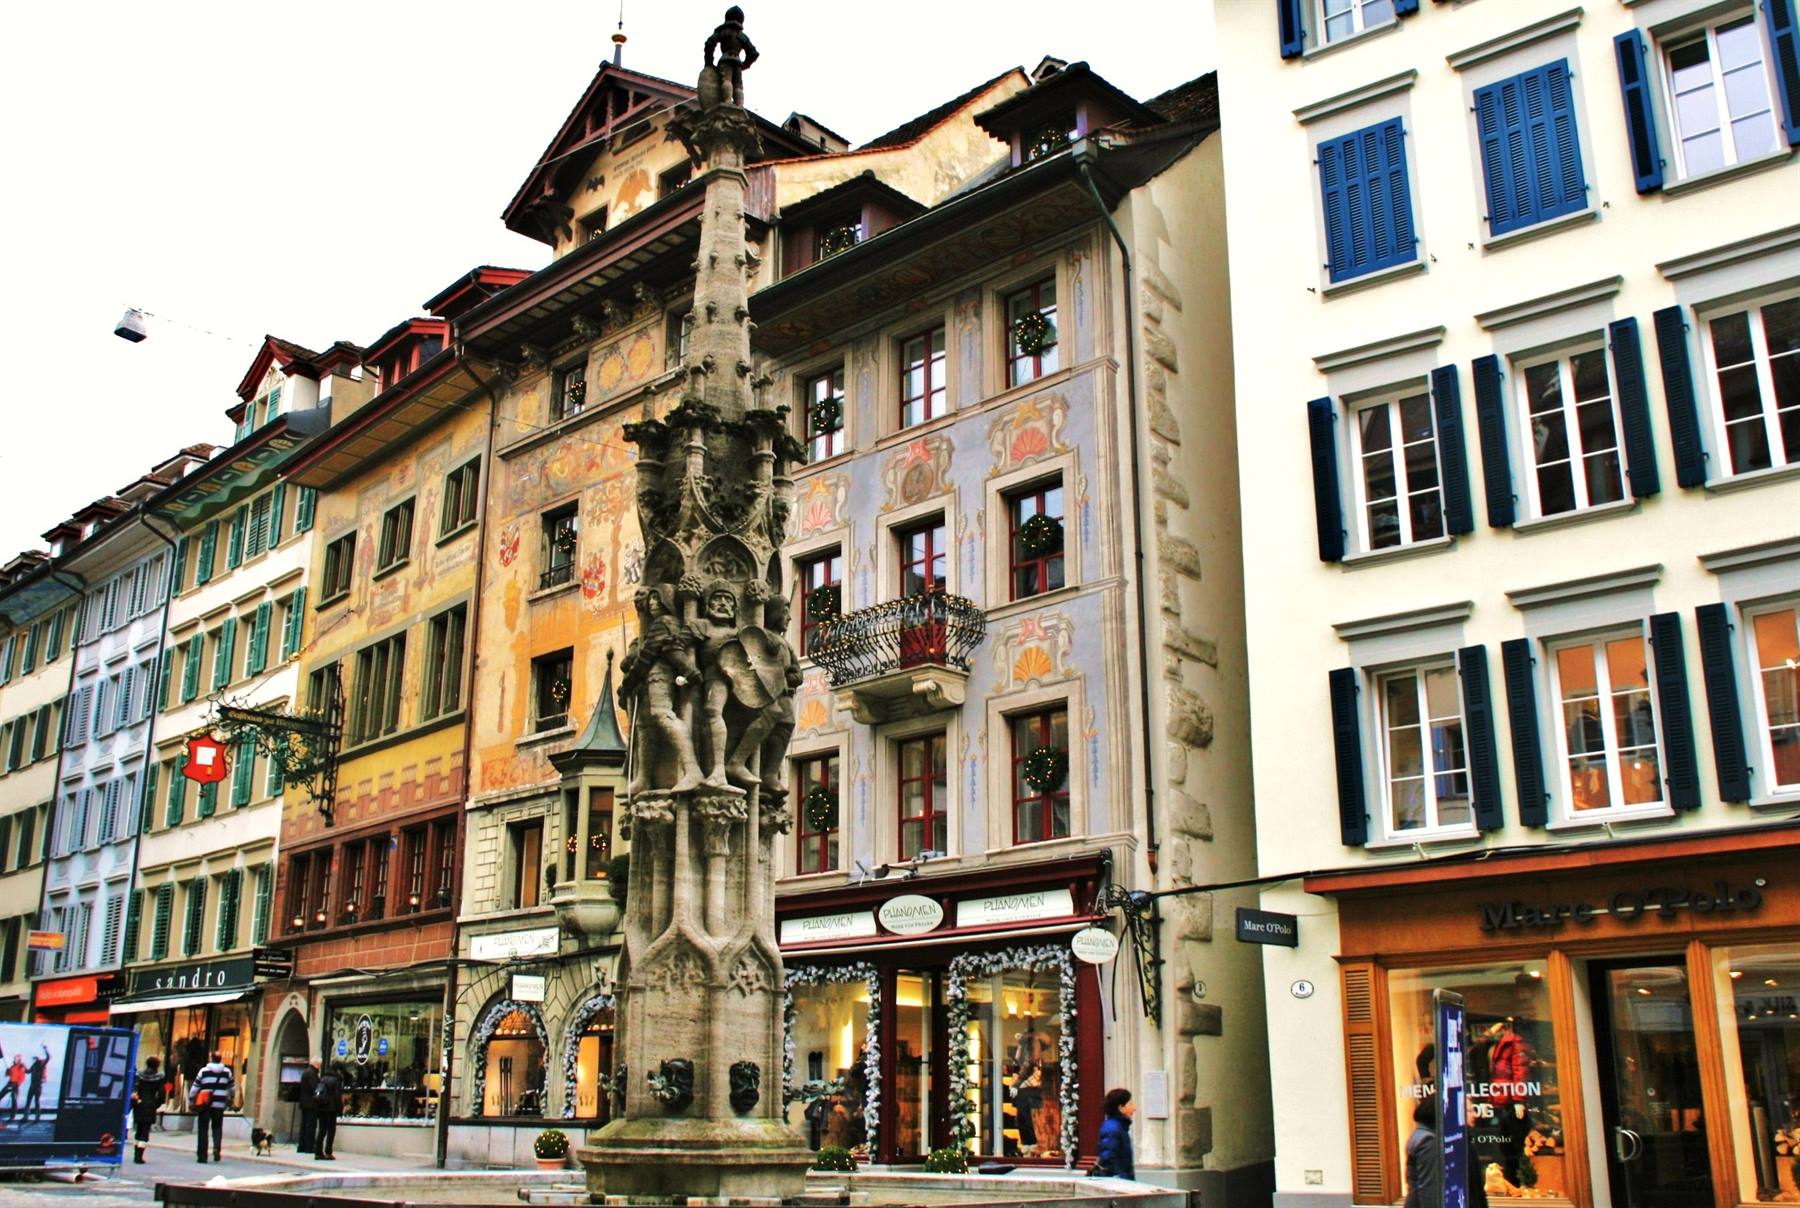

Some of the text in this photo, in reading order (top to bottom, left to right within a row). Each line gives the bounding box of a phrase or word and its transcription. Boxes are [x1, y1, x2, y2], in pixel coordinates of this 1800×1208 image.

[1480, 881, 1763, 931] Marc O'Polo
[1243, 920, 1292, 935] Marc O'Polo
[155, 967, 226, 989] sandro
[1299, 982, 1305, 991] 6
[1466, 1081, 1541, 1098] LECTION
[1477, 1134, 1511, 1144] O'Polo
